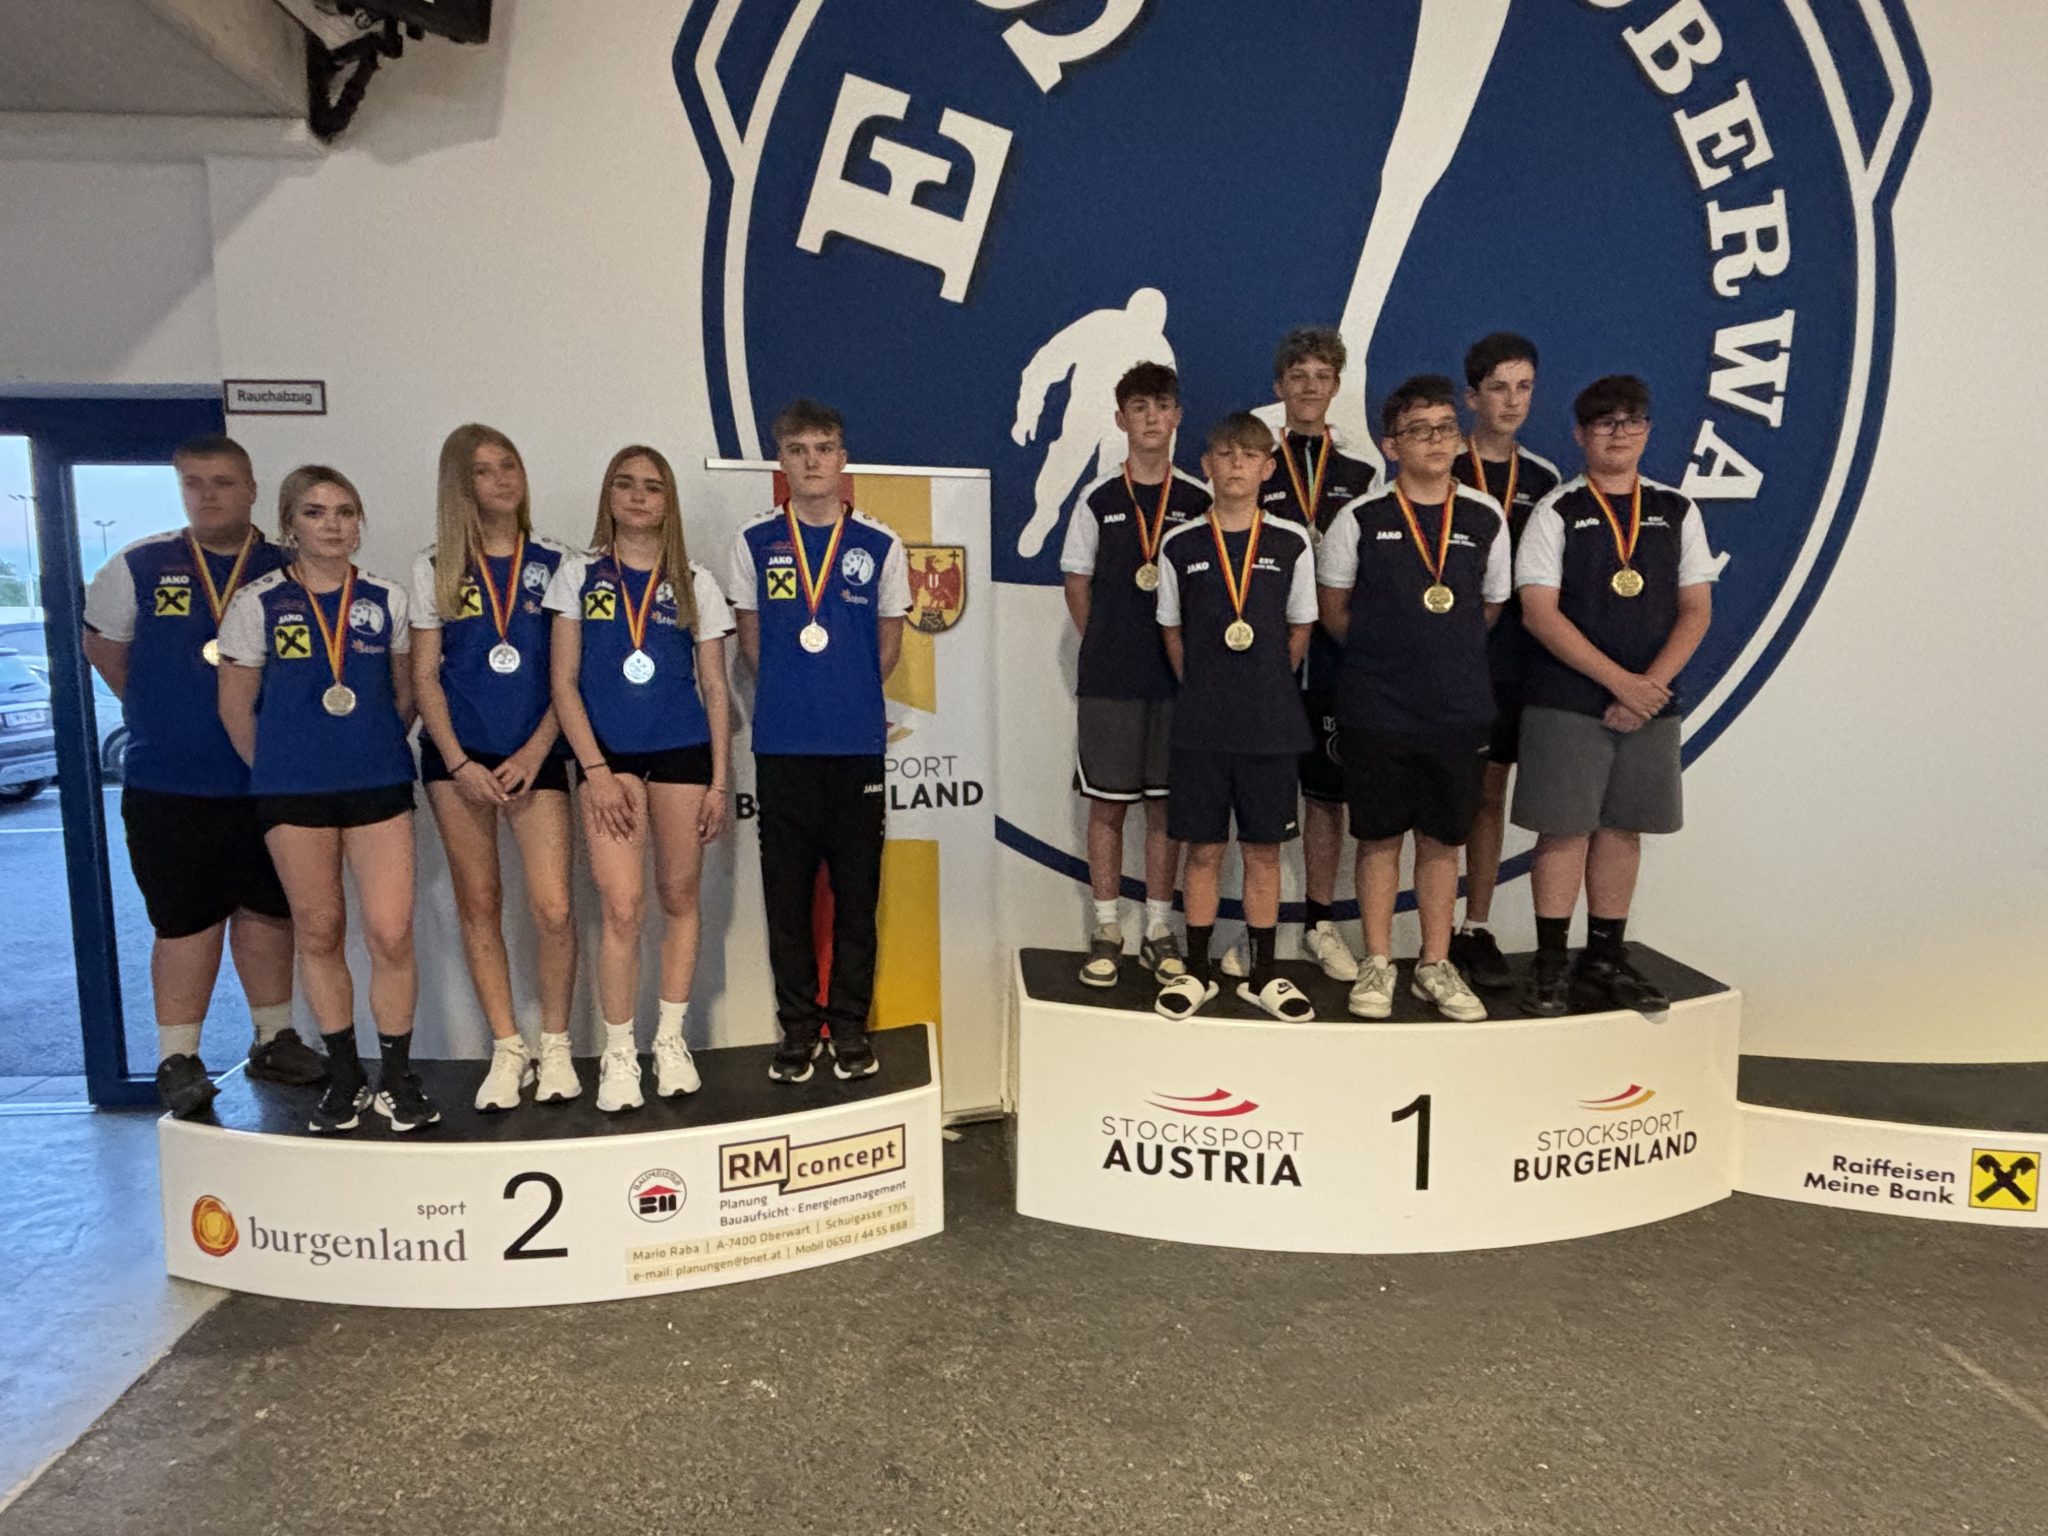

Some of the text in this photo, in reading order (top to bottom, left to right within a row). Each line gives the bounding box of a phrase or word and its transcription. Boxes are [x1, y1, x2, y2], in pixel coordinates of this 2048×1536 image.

[1580, 0, 1796, 582] BERWA
[237, 389, 313, 405] Rauchabzug
[159, 575, 190, 585] JAKO
[767, 556, 793, 566] JAKO
[1187, 561, 1210, 575] JAKO
[1102, 1115, 1304, 1152] STOCKSPORT
[1391, 1094, 1431, 1191] 1
[1537, 1109, 1684, 1152] STOCKSPORT
[729, 1140, 896, 1181] RM concept
[1102, 1139, 1303, 1188] AUSTRIA
[1513, 1131, 1698, 1183] BURGENLAND
[1832, 1155, 1955, 1184] Raiffeisen
[416, 1201, 467, 1218] sport
[720, 1195, 767, 1210] Planung
[720, 1180, 907, 1227] Bauaufsicht Energiemanagement
[1803, 1172, 1955, 1205] Meine Bank
[503, 1171, 568, 1260] 2
[633, 1249, 666, 1261] Mario
[670, 1244, 699, 1257] Raba
[716, 1234, 757, 1250] A-7400
[759, 1225, 810, 1243] Oberwart
[825, 1210, 883, 1231] Schulgasse
[248, 1216, 468, 1266] burgenland
[633, 1268, 673, 1281] e-mail:
[676, 1251, 782, 1278] planungen@bnet.at
[795, 1240, 824, 1255] Mobil
[826, 1235, 852, 1248] 0650
[861, 1229, 874, 1240] 44
